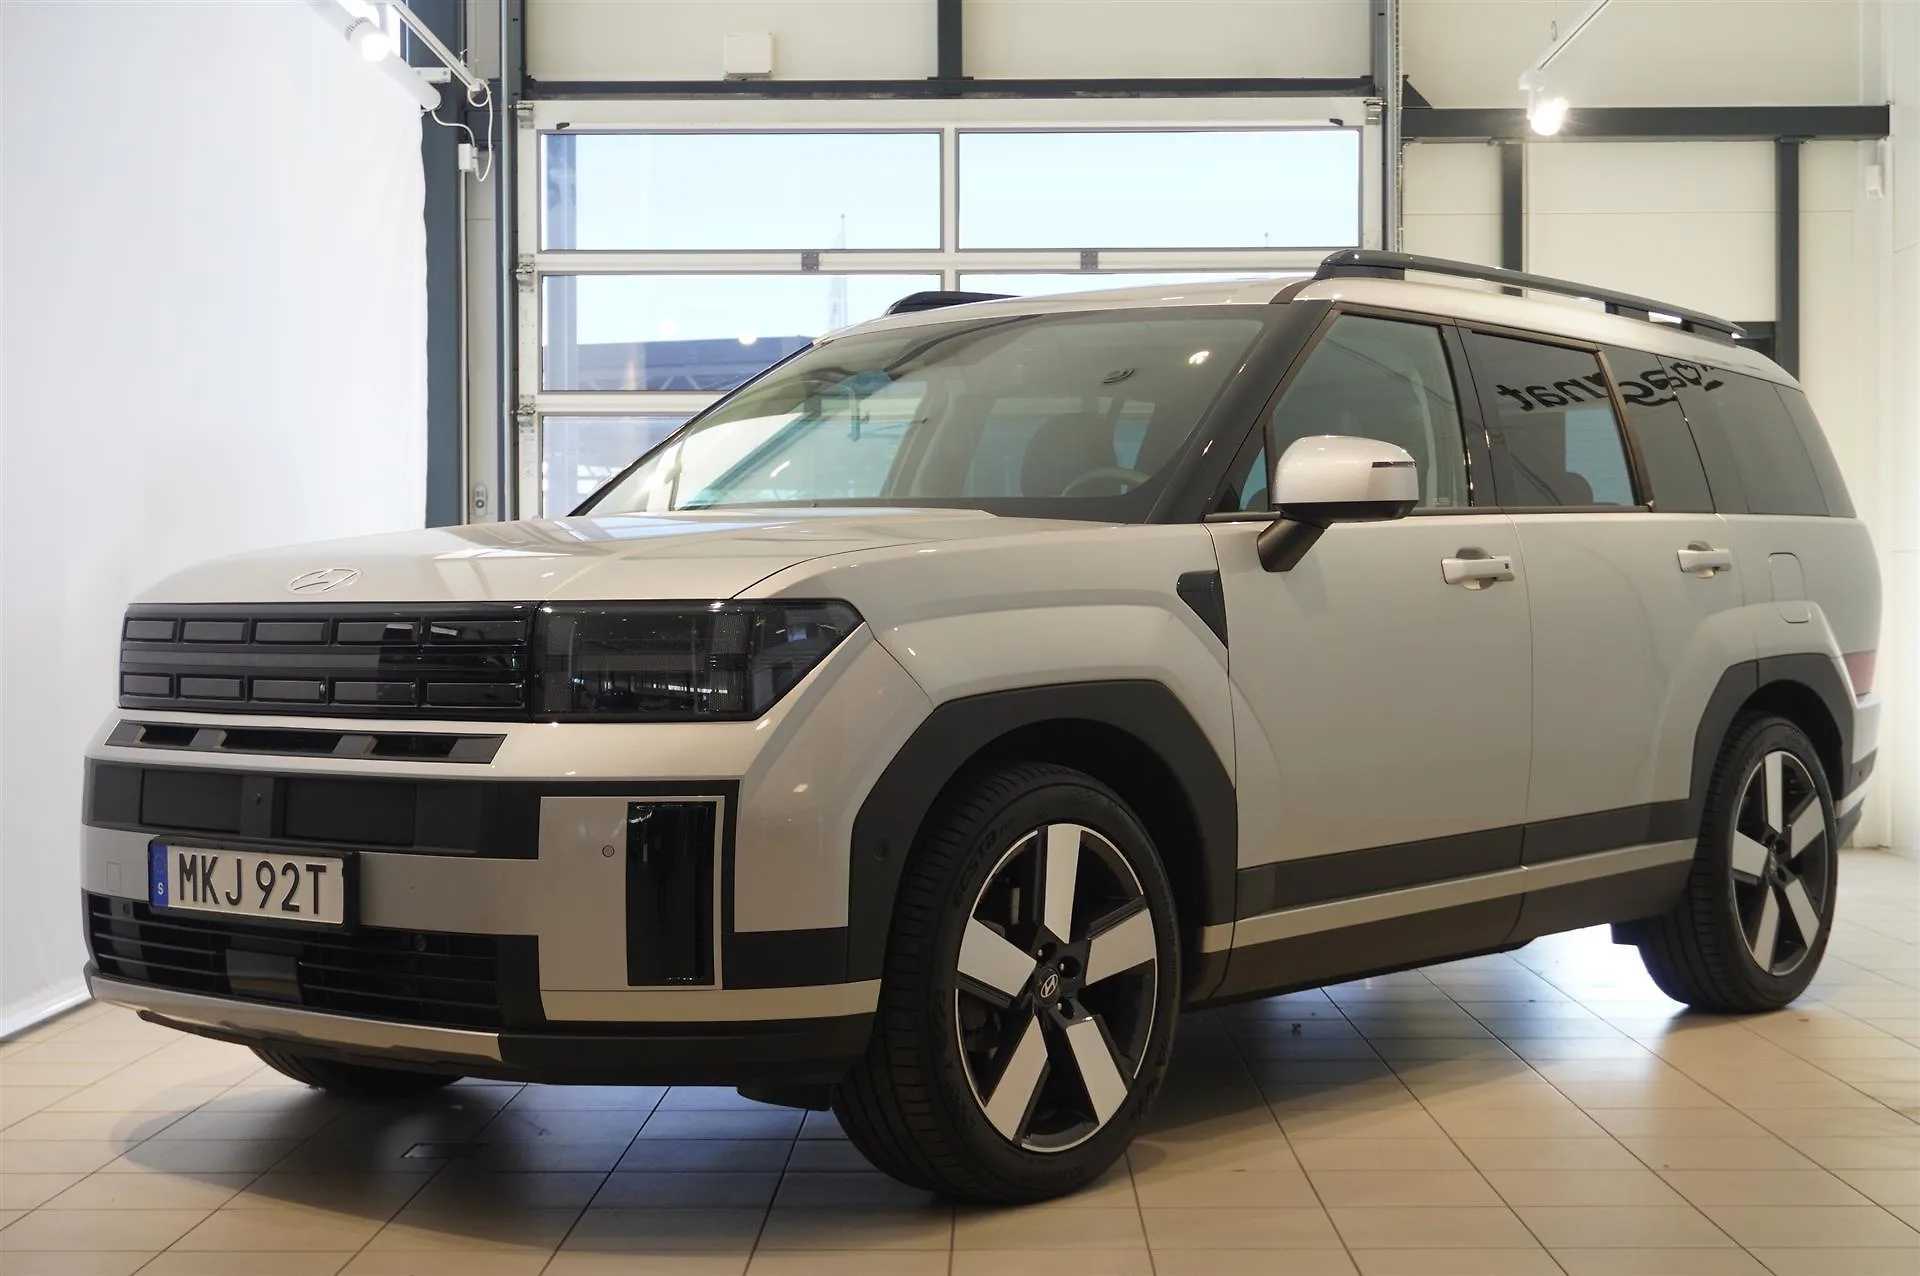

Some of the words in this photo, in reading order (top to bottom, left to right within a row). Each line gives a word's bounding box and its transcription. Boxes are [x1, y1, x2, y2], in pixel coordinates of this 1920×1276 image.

[157, 882, 164, 895] S
[178, 852, 242, 906] MKJ
[255, 860, 327, 914] 92T
